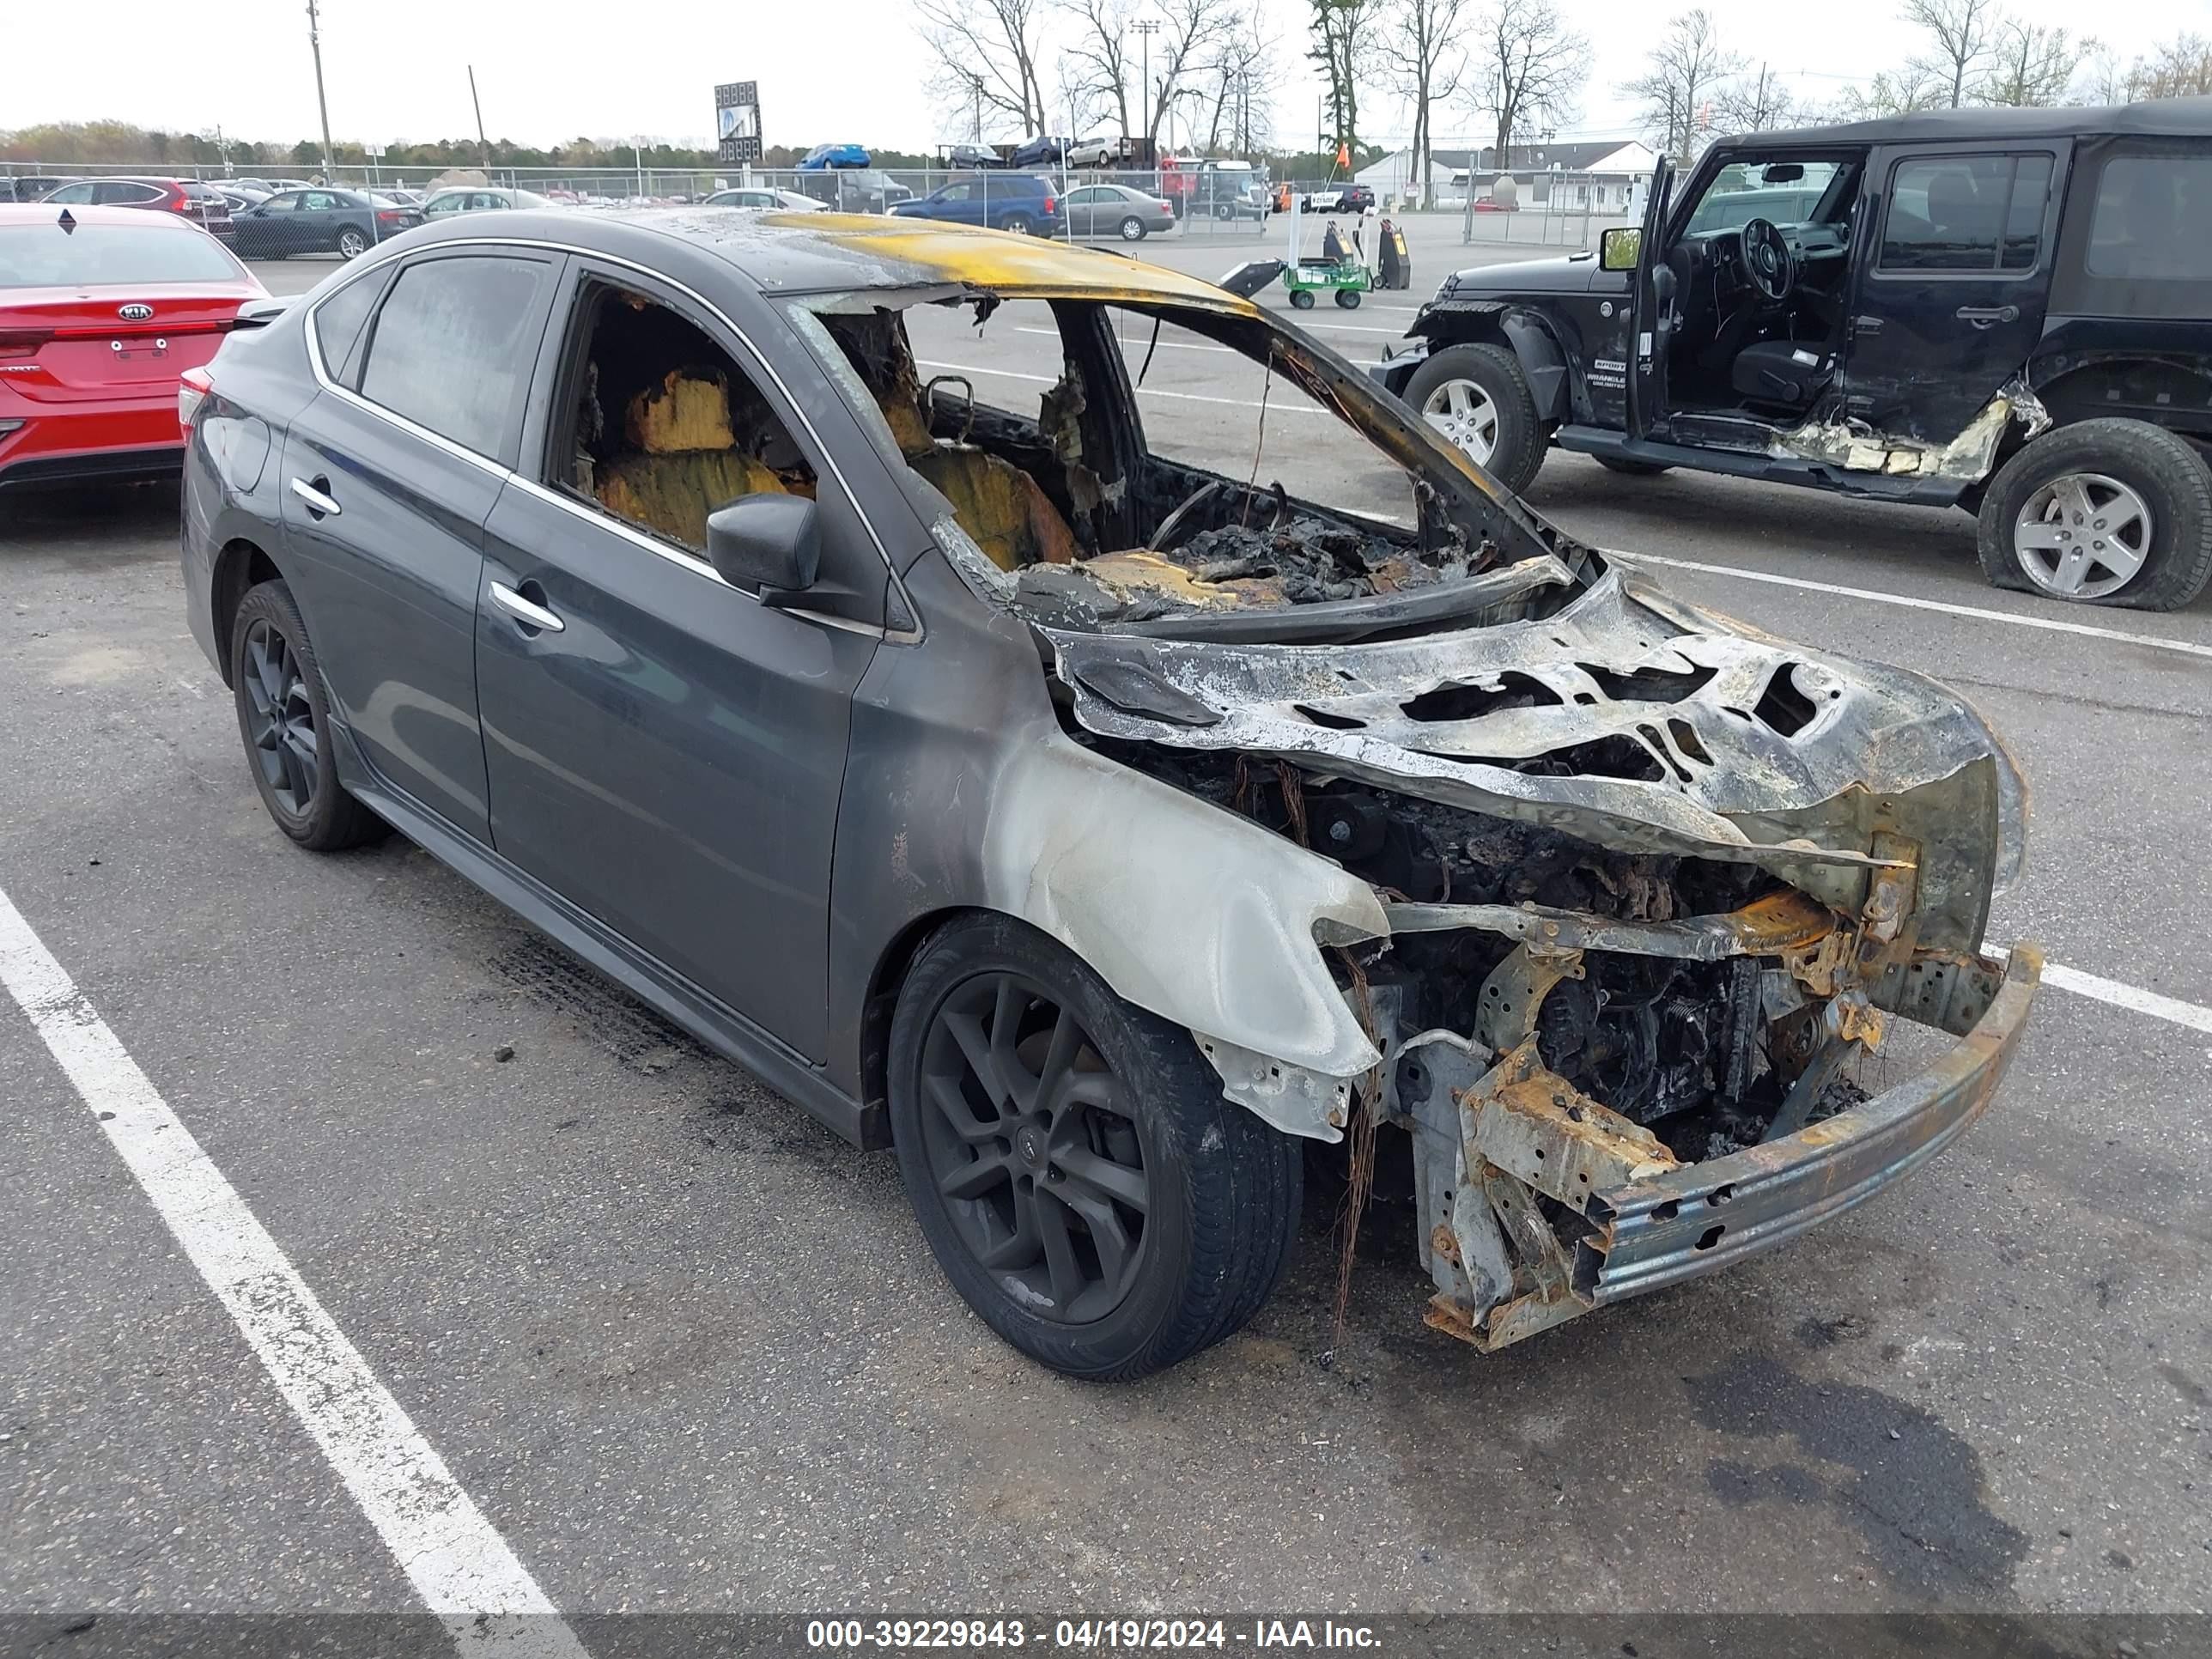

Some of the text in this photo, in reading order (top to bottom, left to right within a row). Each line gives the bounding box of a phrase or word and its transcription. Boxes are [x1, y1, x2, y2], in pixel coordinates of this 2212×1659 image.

[123, 307, 149, 319] KIA
[1595, 361, 1626, 371] SPORT
[1587, 374, 1626, 383] WRANGLE
